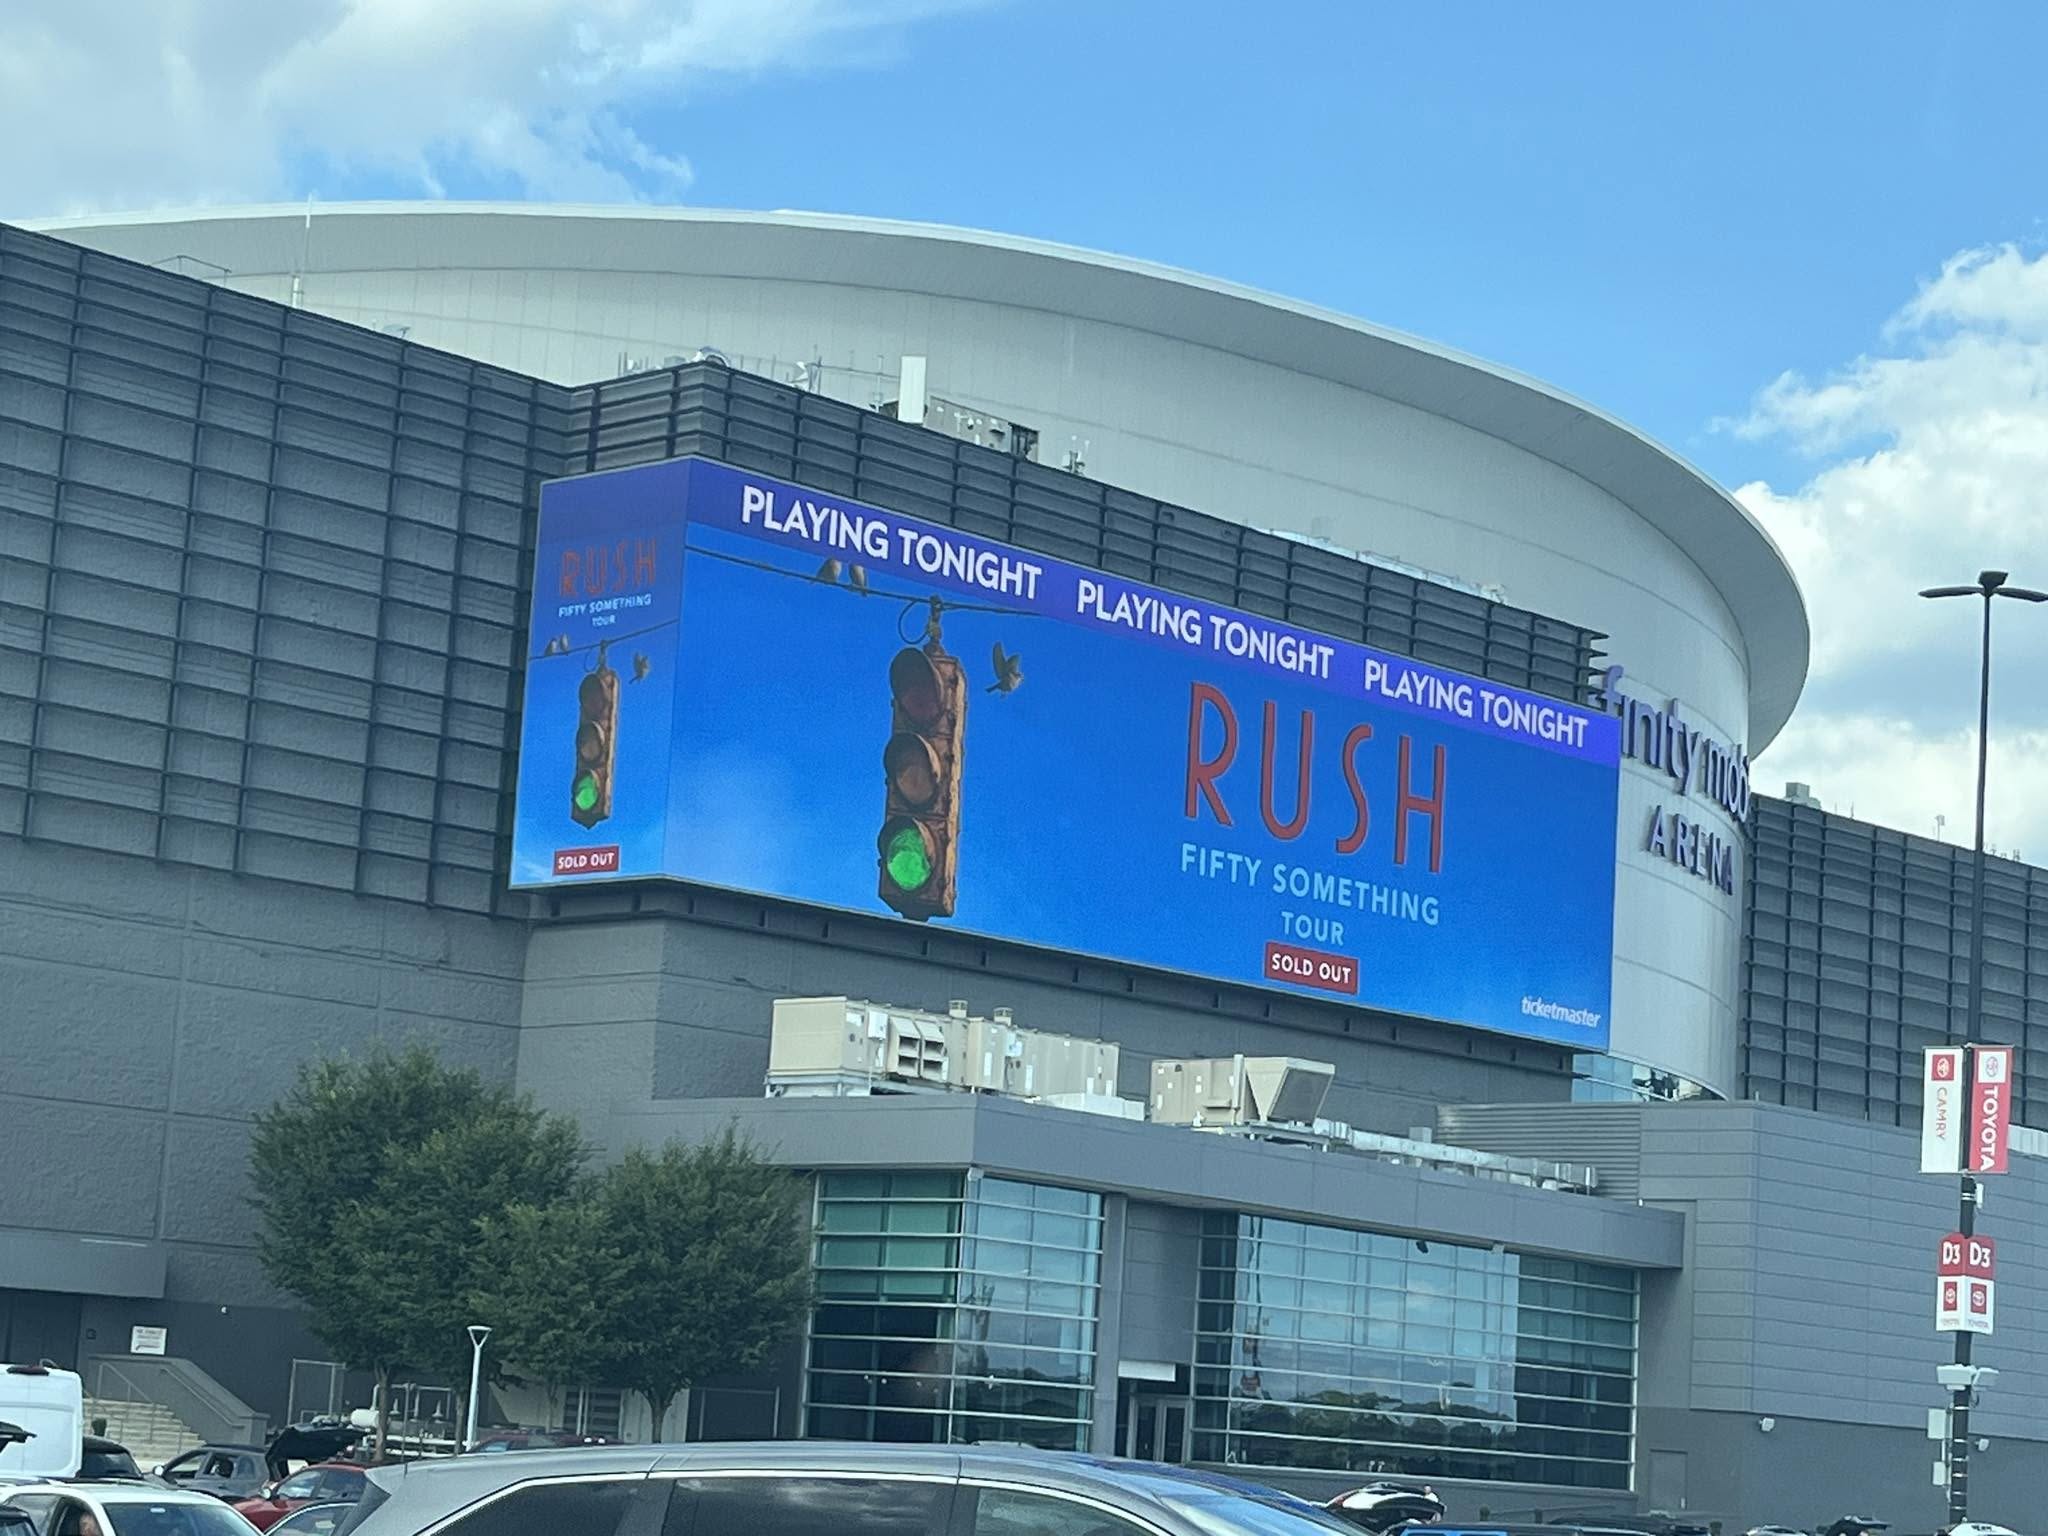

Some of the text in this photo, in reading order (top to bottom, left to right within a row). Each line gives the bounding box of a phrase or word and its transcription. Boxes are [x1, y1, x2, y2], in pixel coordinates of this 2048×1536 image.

[560, 537, 656, 598] RUSH
[742, 484, 1042, 599] PLAYING TONIGHT
[558, 593, 652, 617] FIFTY SOMETHING
[592, 614, 616, 627] TOUR
[1077, 579, 1334, 679] PLAYING TONIGHT
[1364, 658, 1588, 748] PLAYING TONIGHT
[1602, 665, 1750, 823] finity mob
[1184, 681, 1446, 874] RUSH
[558, 852, 615, 870] SOLD OUT
[1649, 805, 1733, 895] ARENA
[1181, 843, 1440, 925] FIFTY SOMETHING
[1281, 911, 1344, 946] TOUR
[1271, 953, 1352, 984] SOLD OUT
[1521, 995, 1602, 1028] ticketmaster
[1936, 1087, 1948, 1141] CAMRY
[1980, 1085, 1999, 1172] TOYOTA
[1942, 1241, 1961, 1266] D3
[1969, 1241, 1991, 1269] D3
